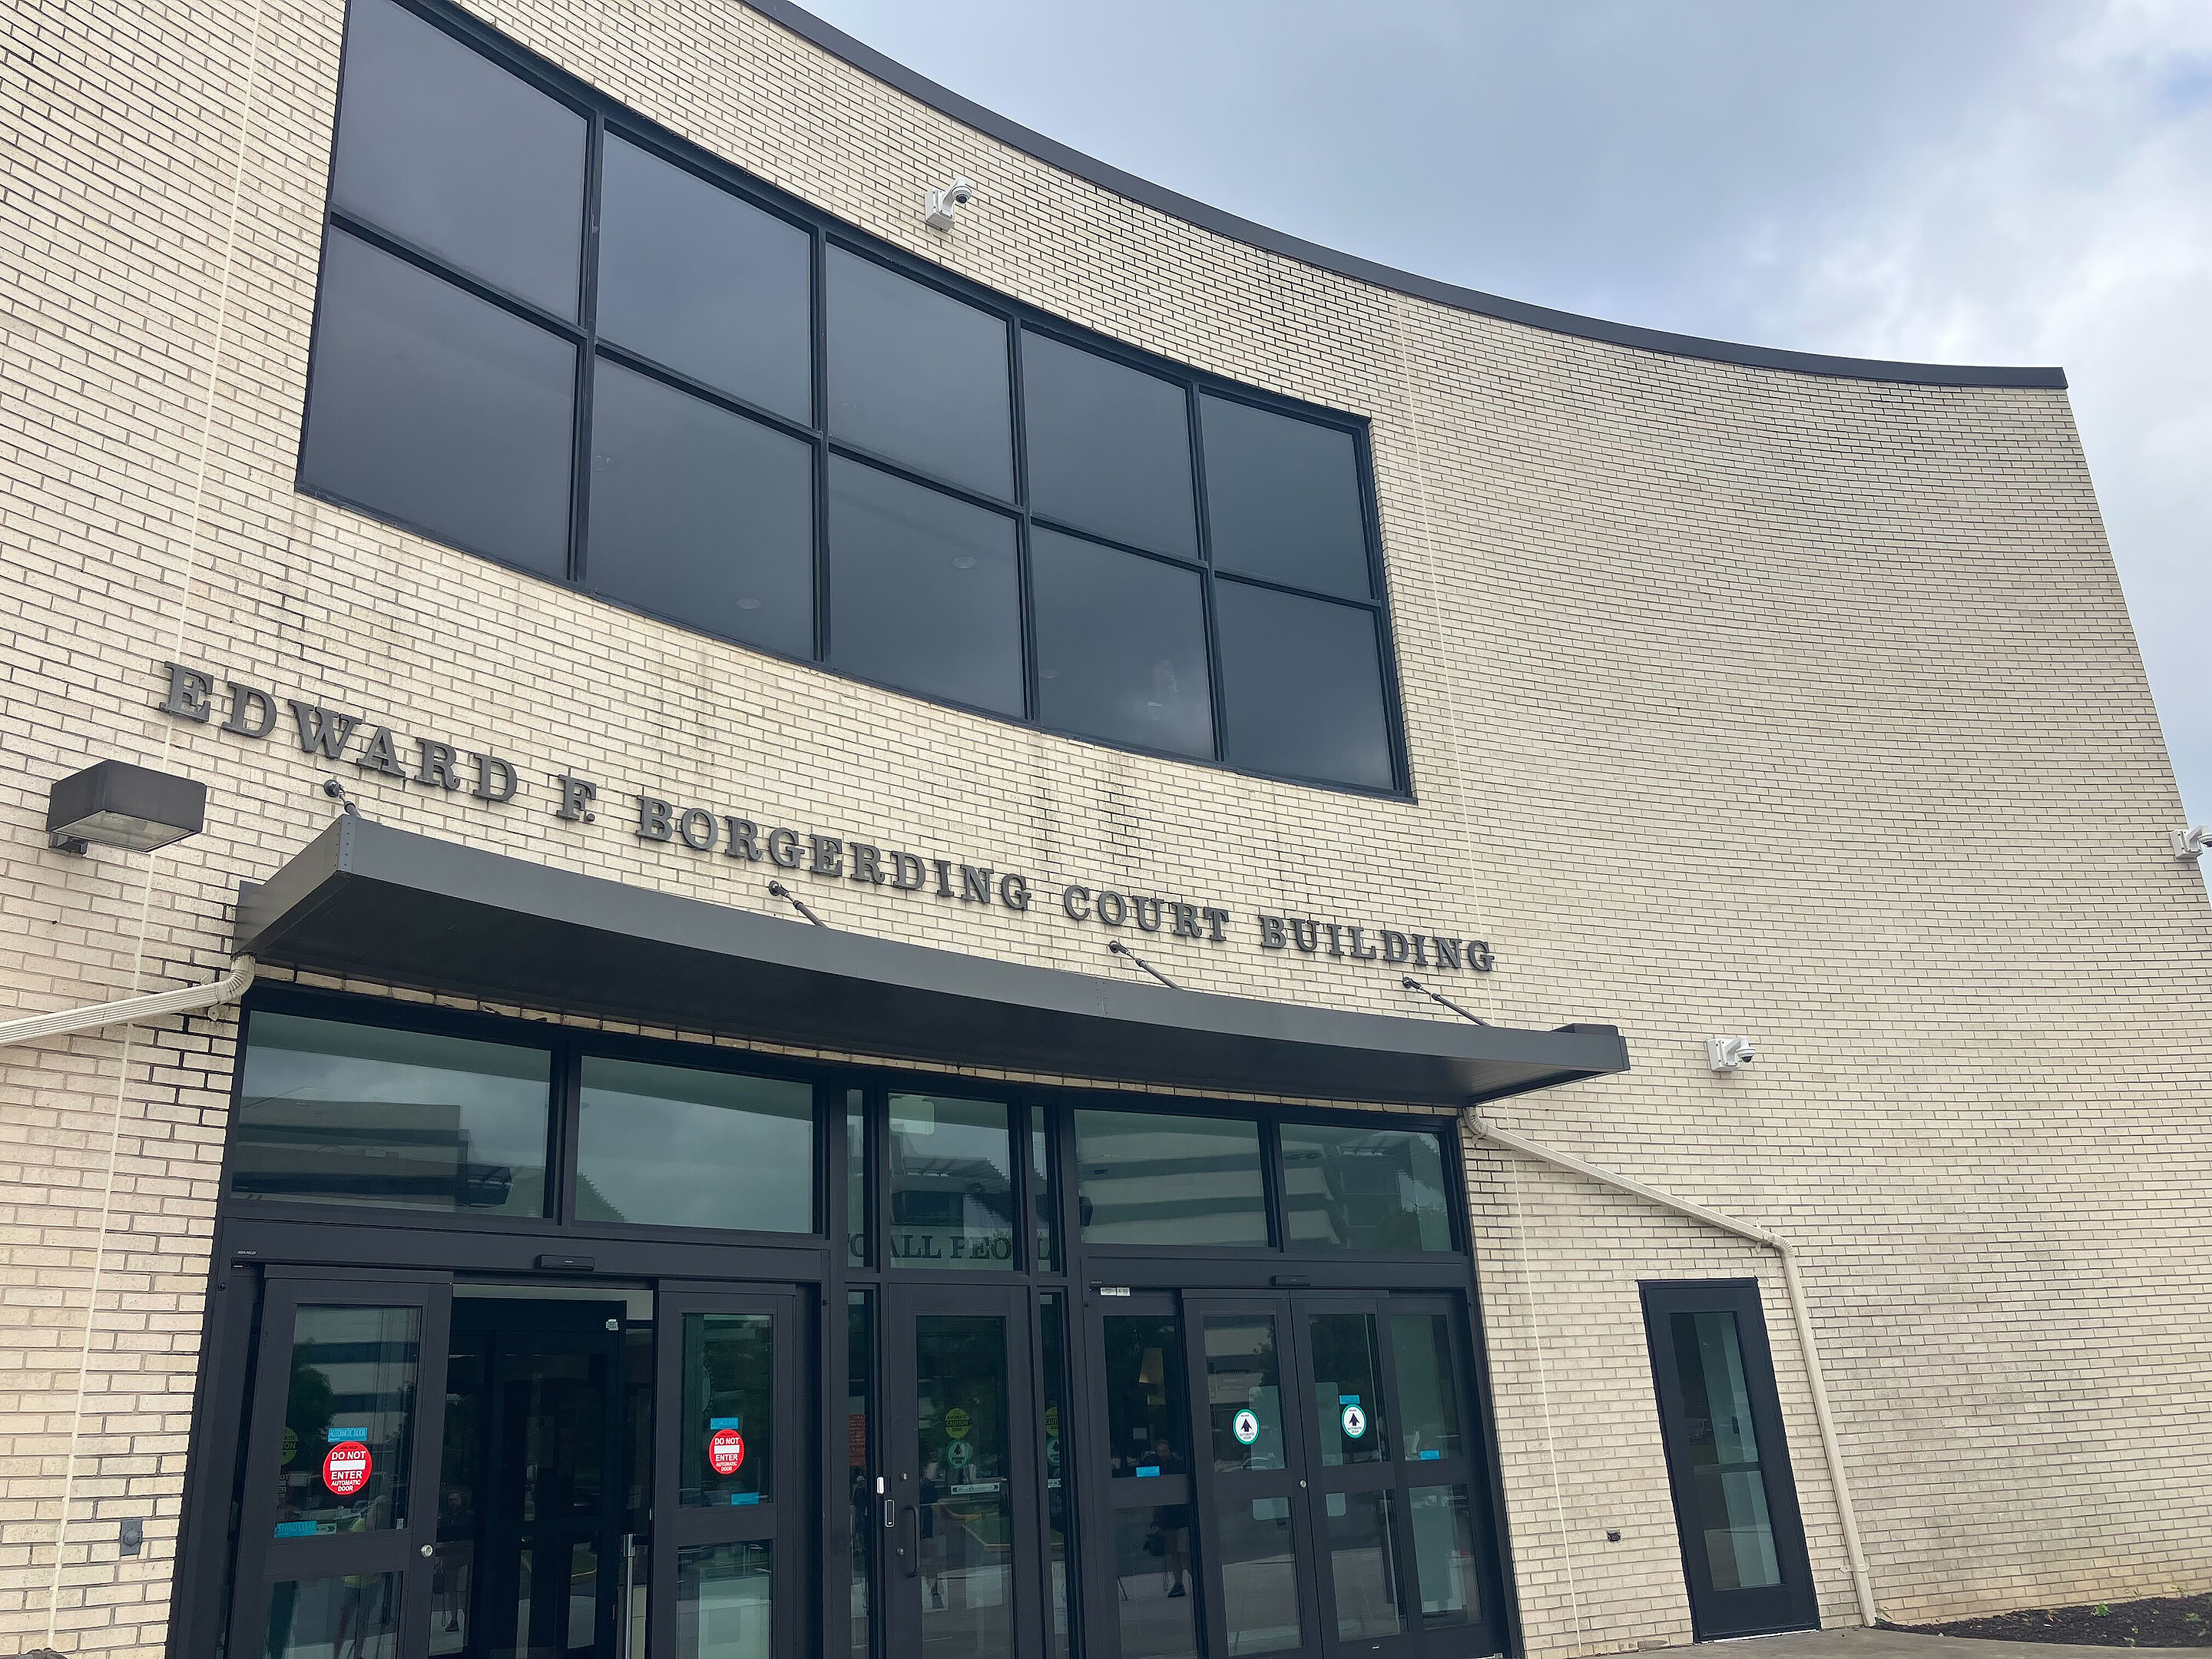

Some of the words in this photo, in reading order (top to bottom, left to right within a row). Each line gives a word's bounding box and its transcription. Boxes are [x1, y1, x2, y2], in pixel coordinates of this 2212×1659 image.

[157, 661, 518, 803] EDWARD
[557, 774, 598, 823] F.
[635, 793, 1032, 912] BORGERDING
[1064, 883, 1229, 942] COURT
[1259, 913, 1495, 972] BUILDING
[332, 1452, 345, 1460] DO
[347, 1450, 366, 1459] NOT
[331, 1471, 362, 1480] ENTER
